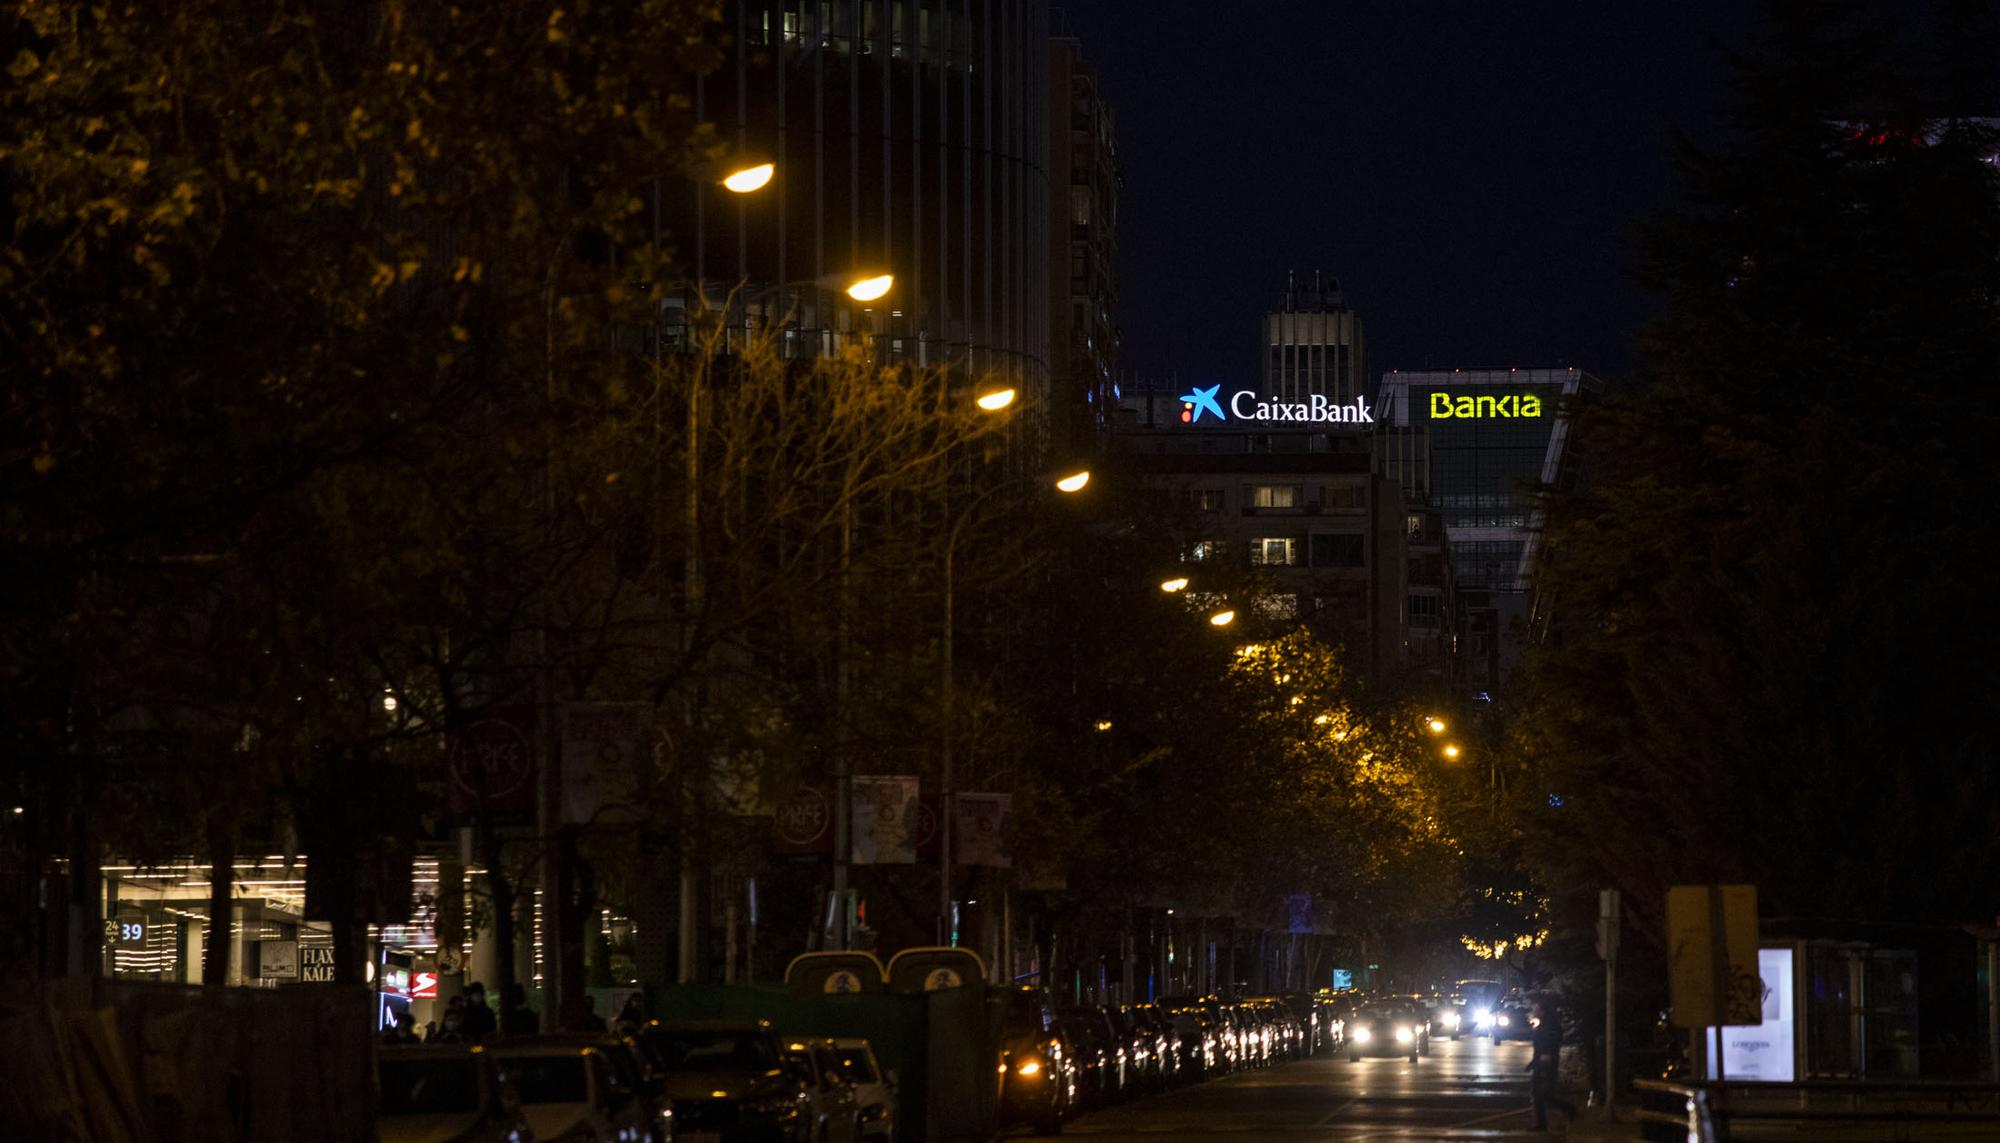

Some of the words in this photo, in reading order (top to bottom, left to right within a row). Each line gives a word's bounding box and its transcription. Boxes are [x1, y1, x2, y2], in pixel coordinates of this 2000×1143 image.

[1231, 390, 1374, 423] CaixaBank
[1430, 392, 1541, 419] Bankia
[122, 923, 143, 941] 39
[303, 949, 335, 964] FLAX
[303, 966, 335, 982] KALE
